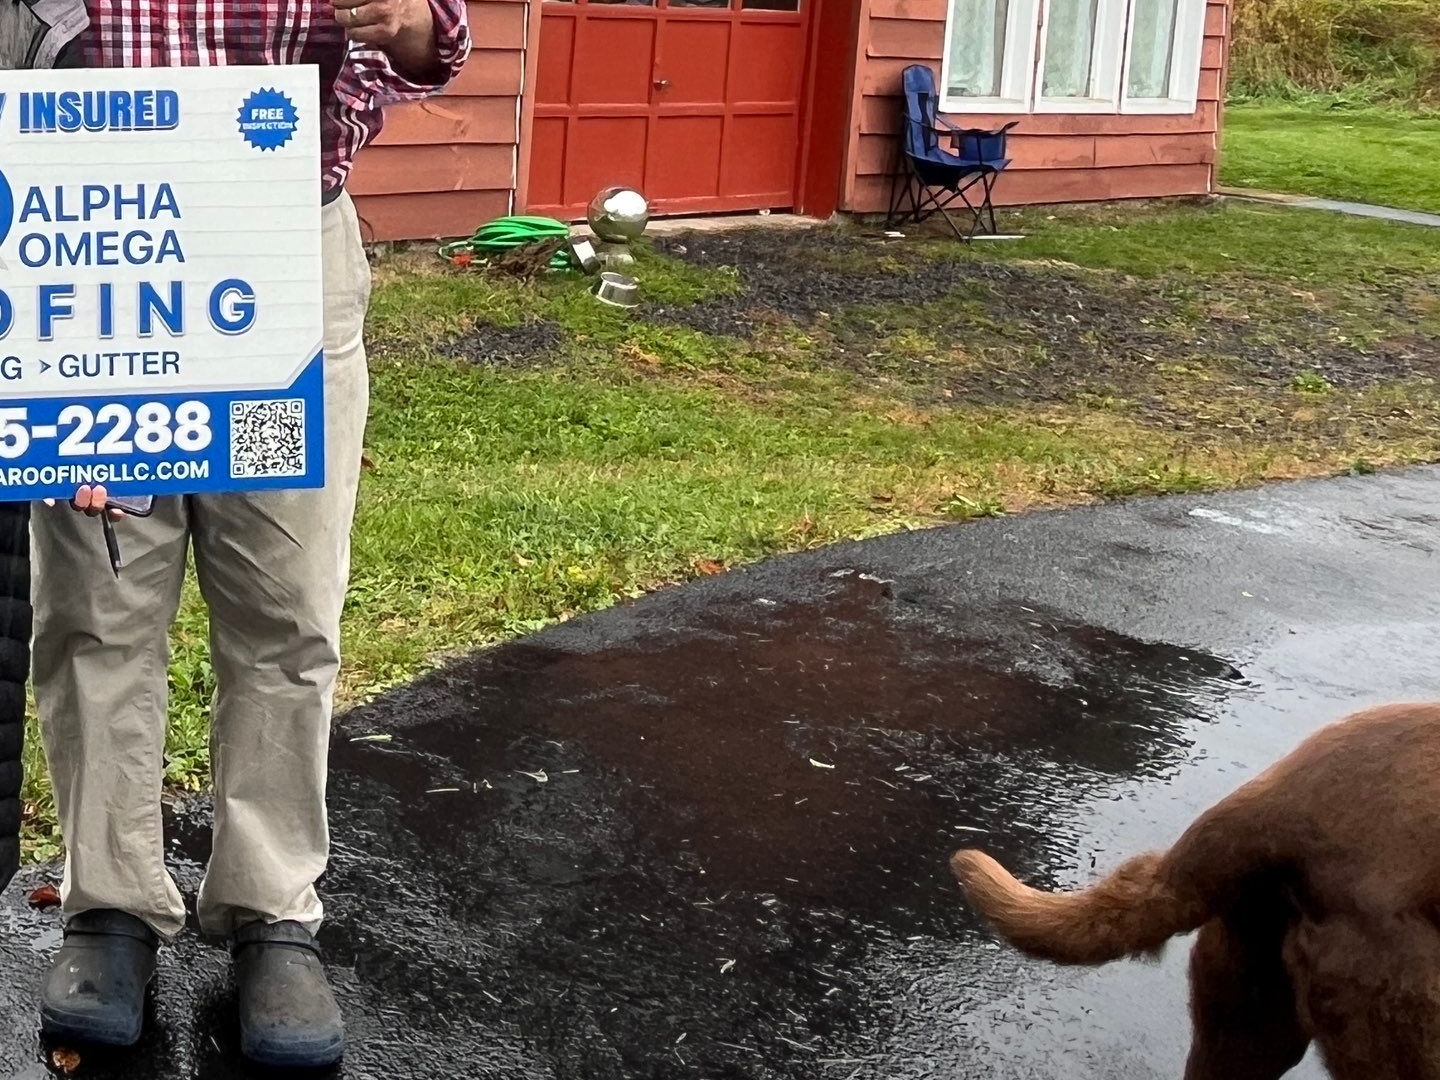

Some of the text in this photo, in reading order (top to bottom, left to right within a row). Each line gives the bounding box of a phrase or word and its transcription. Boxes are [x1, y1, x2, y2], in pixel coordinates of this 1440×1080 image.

[19, 89, 180, 133] INSURED
[251, 108, 284, 120] FREE
[18, 183, 182, 223] ALPHA
[18, 229, 186, 268] OMEGA
[58, 351, 181, 377] GUTTER
